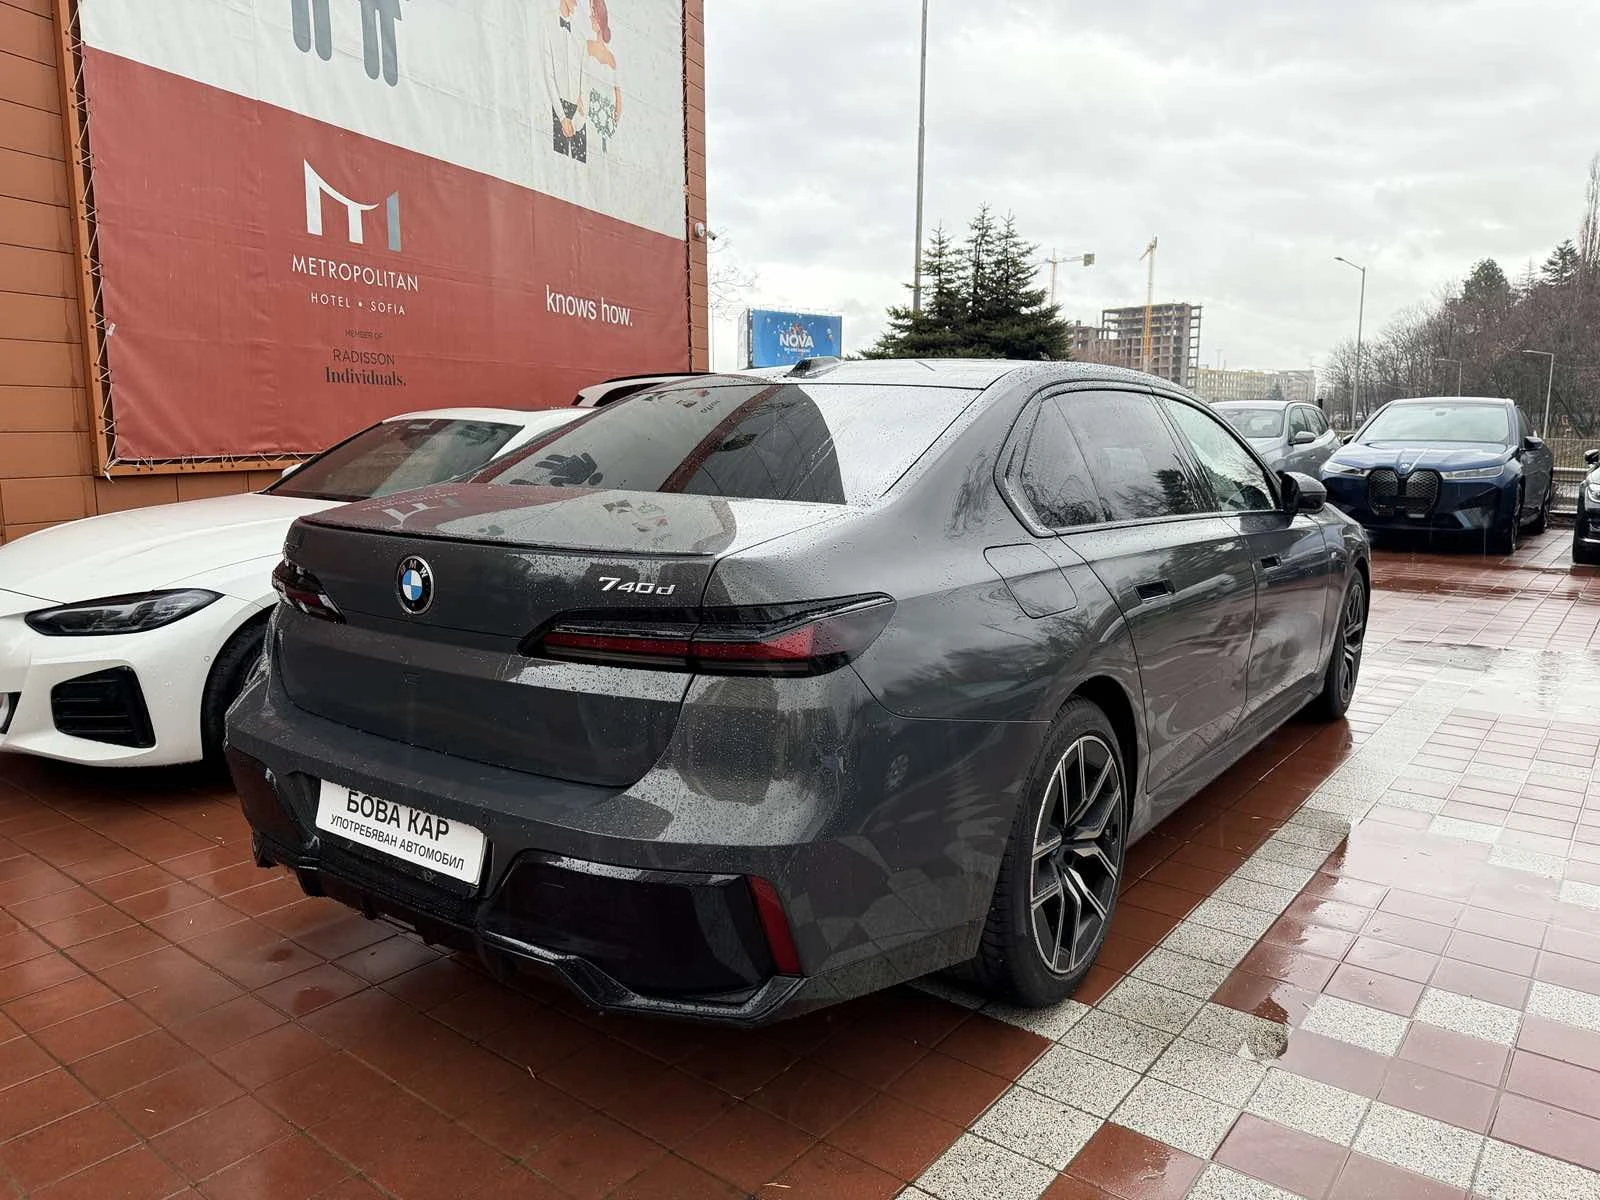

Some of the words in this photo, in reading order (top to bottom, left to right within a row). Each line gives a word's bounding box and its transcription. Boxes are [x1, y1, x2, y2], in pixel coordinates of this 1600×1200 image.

[292, 254, 418, 292] METROPOLITAN
[311, 292, 350, 308] HOTEL
[370, 301, 406, 315] SOFIA
[546, 284, 597, 320] knows
[601, 297, 633, 327] how.
[780, 334, 815, 348] NOVA
[333, 349, 395, 365] RADISSON
[325, 367, 407, 387] Individuals.
[598, 576, 676, 595] 740d
[347, 791, 400, 828] БОВА
[407, 809, 450, 842] КАР
[330, 814, 398, 847] УПОТРЕБЯВАН
[399, 839, 465, 871] АВТОМОБИЛ
